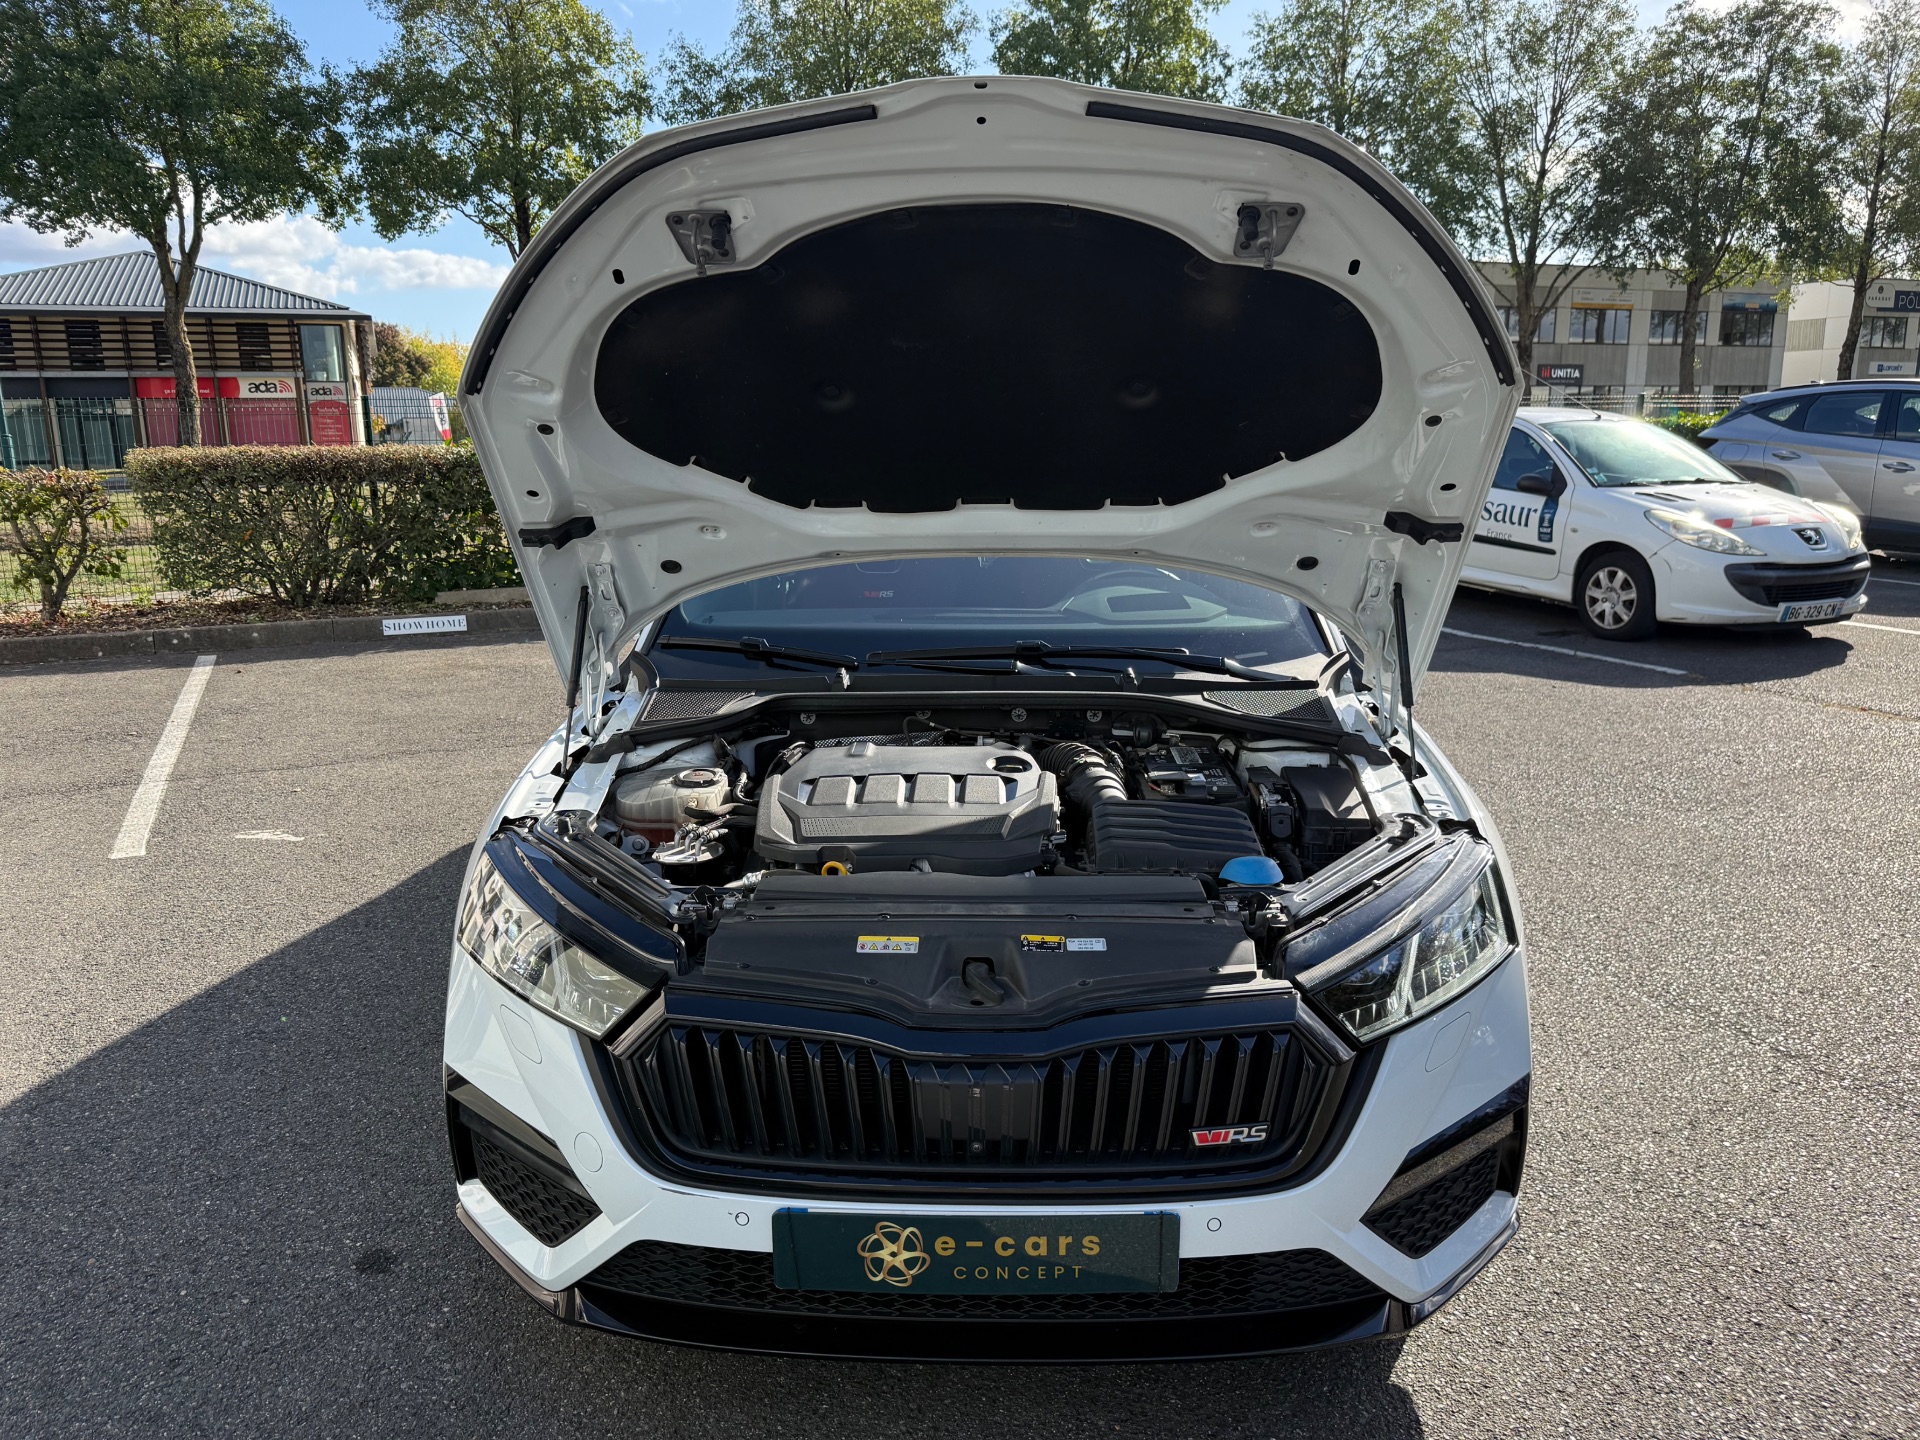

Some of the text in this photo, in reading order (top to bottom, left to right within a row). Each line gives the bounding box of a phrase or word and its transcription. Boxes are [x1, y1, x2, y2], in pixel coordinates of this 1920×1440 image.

[1551, 368, 1580, 378] UNITIA
[247, 380, 278, 394] ada
[310, 385, 332, 396] ada
[1480, 501, 1538, 528] saur
[1486, 528, 1513, 541] France
[384, 618, 466, 632] SHOWHOME
[953, 1265, 1082, 1279] CONCEPT
